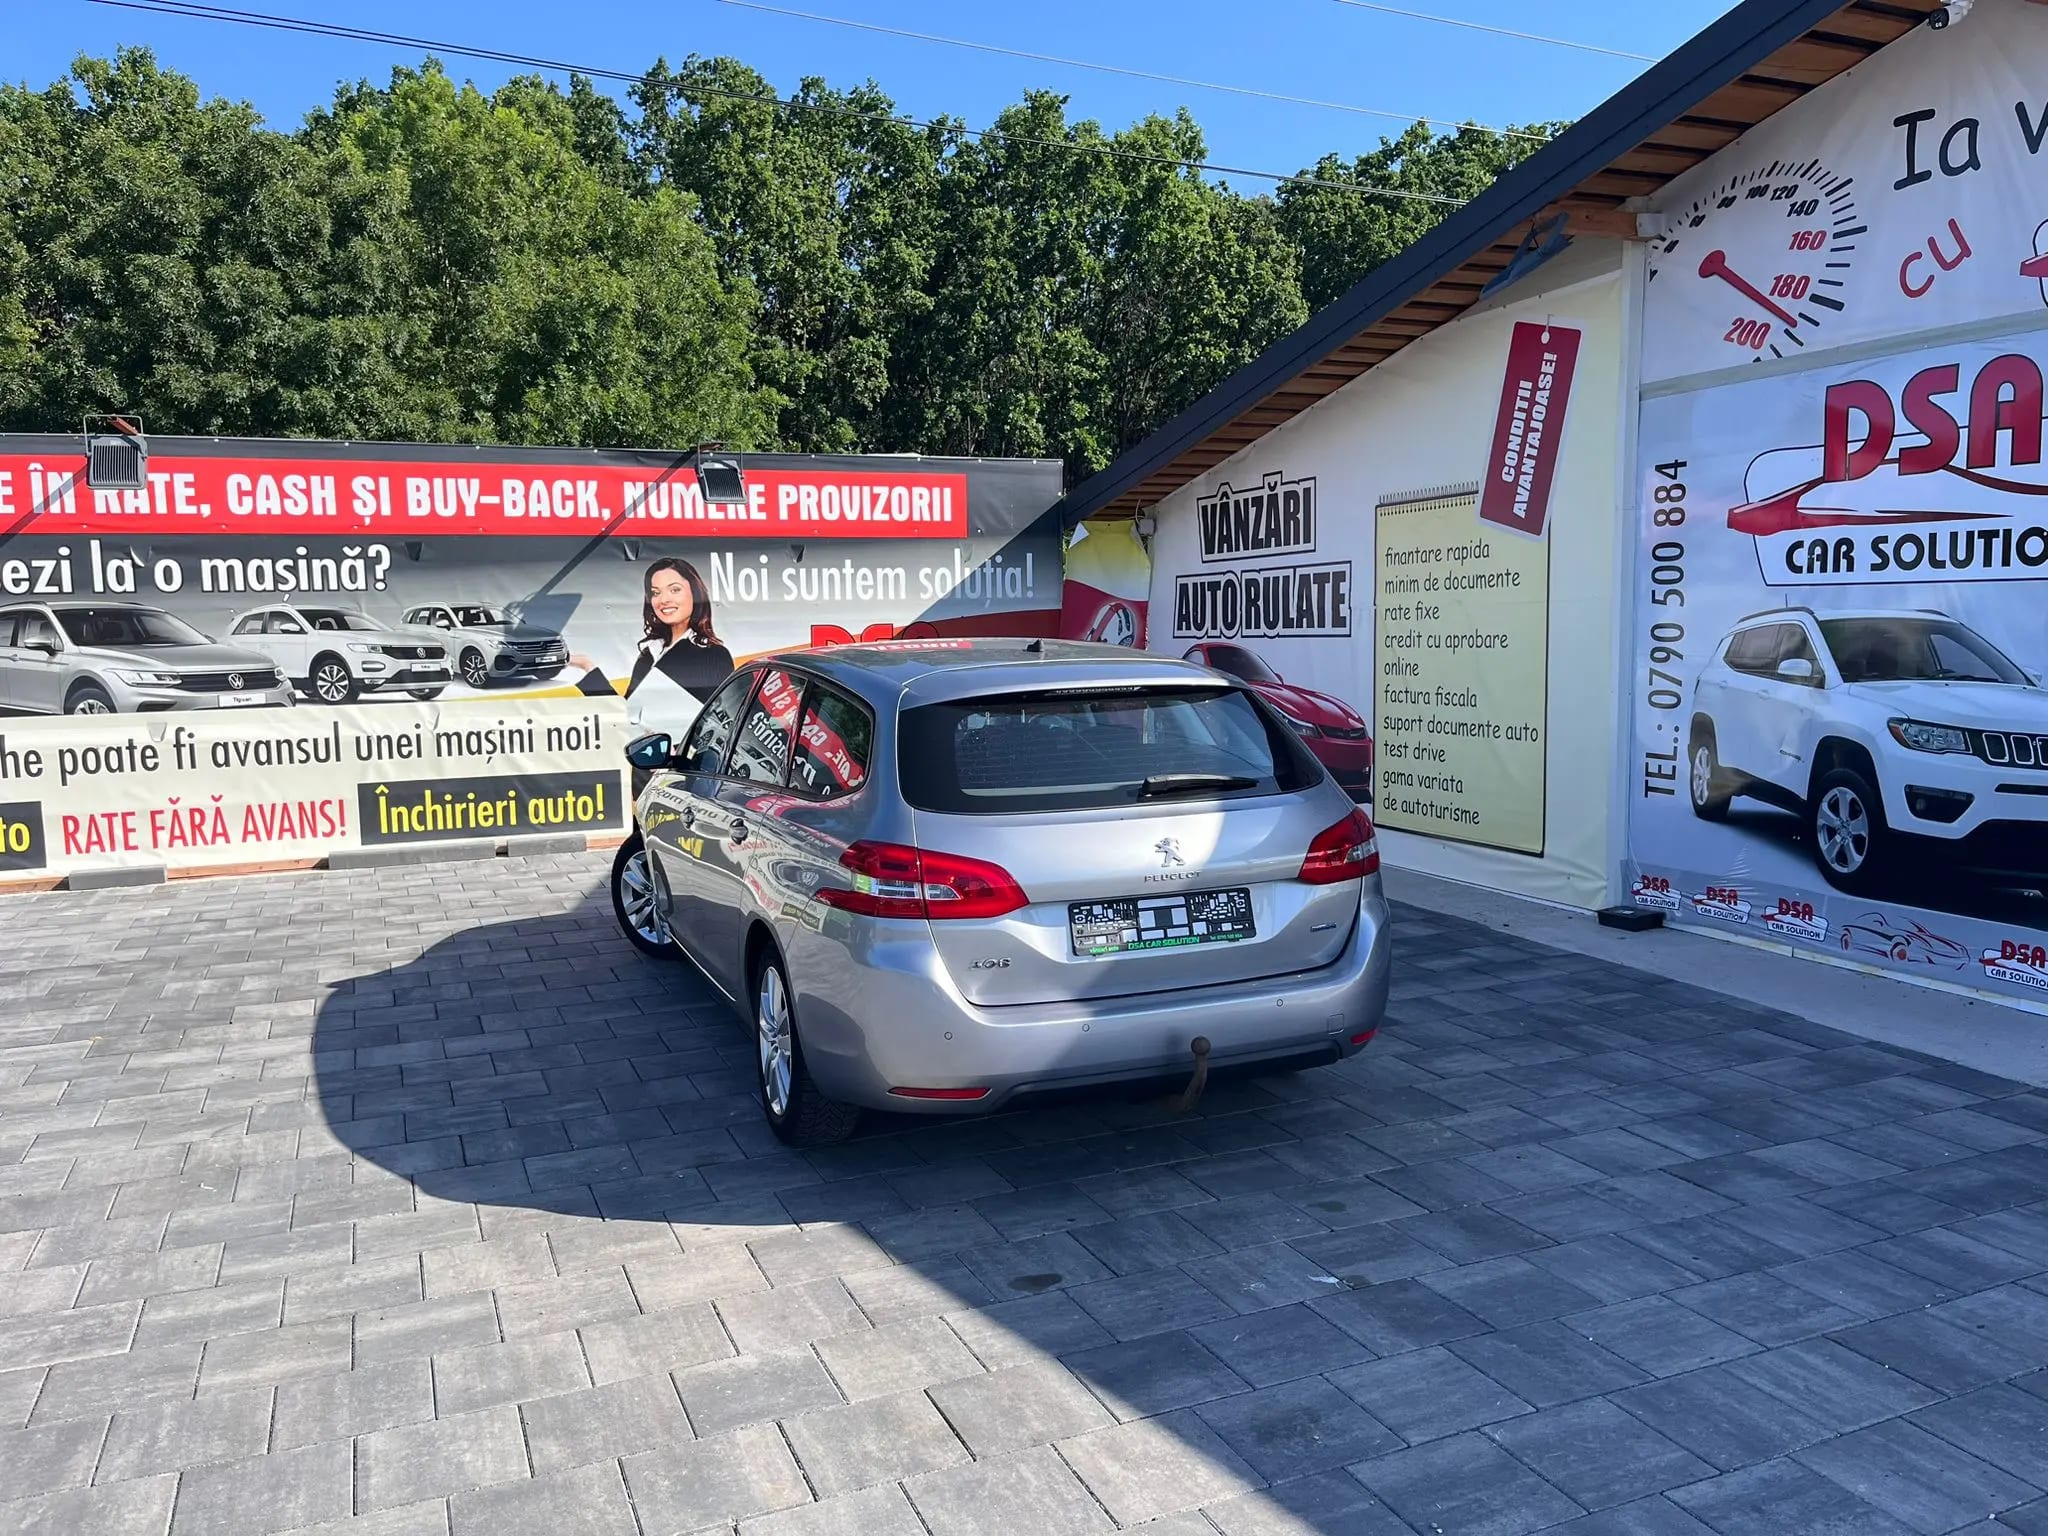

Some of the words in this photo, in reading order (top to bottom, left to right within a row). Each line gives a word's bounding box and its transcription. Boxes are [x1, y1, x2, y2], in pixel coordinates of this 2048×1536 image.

[1893, 108, 1980, 191] Ia
[1745, 184, 1770, 199] 100
[1770, 184, 1799, 201] 120
[1787, 199, 1819, 217] 140
[1789, 230, 1827, 250] 160
[1899, 217, 1972, 299] cu
[1769, 274, 1811, 300] 180
[1723, 317, 1771, 350] 200
[1502, 380, 1533, 483] CONDITII
[1824, 354, 2043, 482] DSA
[1512, 352, 1558, 519] AVANTAJOASE!
[27, 462, 76, 514] ÎN
[93, 473, 211, 518] RATE,
[226, 474, 337, 516] CASH
[351, 476, 391, 526] ȘI
[406, 477, 612, 521] BUY-BACK,
[778, 484, 952, 522] PROVIZORII
[1654, 459, 1687, 527] 884
[1201, 481, 1311, 555] VÂNZĂRI
[1385, 547, 1442, 567] finantare
[1446, 538, 1490, 566] rapida
[1785, 537, 1854, 574] CAR
[0, 546, 72, 594] ezi
[90, 539, 136, 594] la
[153, 558, 182, 593] o
[201, 543, 391, 602] mașină?
[710, 552, 769, 602] Noi
[782, 559, 906, 601] suntem
[918, 547, 1034, 608] soluția!
[1385, 575, 1419, 594] minim
[1424, 572, 1440, 592] de
[1444, 568, 1521, 591] documente
[1651, 542, 1684, 607] 500
[1177, 578, 1237, 631] AUTO
[1245, 571, 1346, 630] RULATE
[1384, 604, 1411, 621] rate
[1415, 601, 1440, 621] fixe
[1384, 629, 1422, 648] credit
[1427, 635, 1441, 648] cu
[1445, 629, 1509, 654] aprobare
[1384, 657, 1420, 676] online
[1648, 623, 1684, 709] 0790
[1384, 684, 1430, 705] factura
[1435, 686, 1477, 707] fiscala
[1384, 715, 1423, 736] suport
[1427, 714, 1501, 739] documente
[1506, 723, 1539, 742] auto
[0, 735, 43, 778] he
[58, 738, 160, 786] poate
[173, 727, 197, 770] fi
[211, 721, 341, 768] avansul
[355, 723, 422, 761] unei
[435, 718, 534, 764] mașini
[547, 714, 601, 751] noi!
[1384, 740, 1409, 758] test
[1413, 741, 1446, 762] drive
[1383, 770, 1413, 789] gama
[1417, 772, 1464, 794] variata
[374, 784, 517, 834] Închirieri
[528, 783, 605, 825] auto!
[1383, 792, 1397, 811] de
[1401, 798, 1480, 825] autoturisme
[62, 811, 139, 855] RATE
[150, 794, 231, 848] FĂRĂ
[241, 799, 346, 843] AVANS!
[1144, 871, 1201, 882] PEUGEOT
[1641, 875, 1669, 893] DSA
[1649, 899, 1676, 908] SOLUTION
[1706, 886, 1738, 906] DSA
[1778, 898, 1813, 922] DSA
[1713, 909, 1744, 921] SOLUTION
[1145, 940, 1162, 949] CAR
[1162, 936, 1200, 948] SOLUTION
[1786, 925, 1820, 939] SOLUTION
[2001, 940, 2046, 969] DSA
[1991, 968, 2007, 978] CAR
[2009, 972, 2048, 989] SOLUTIO
